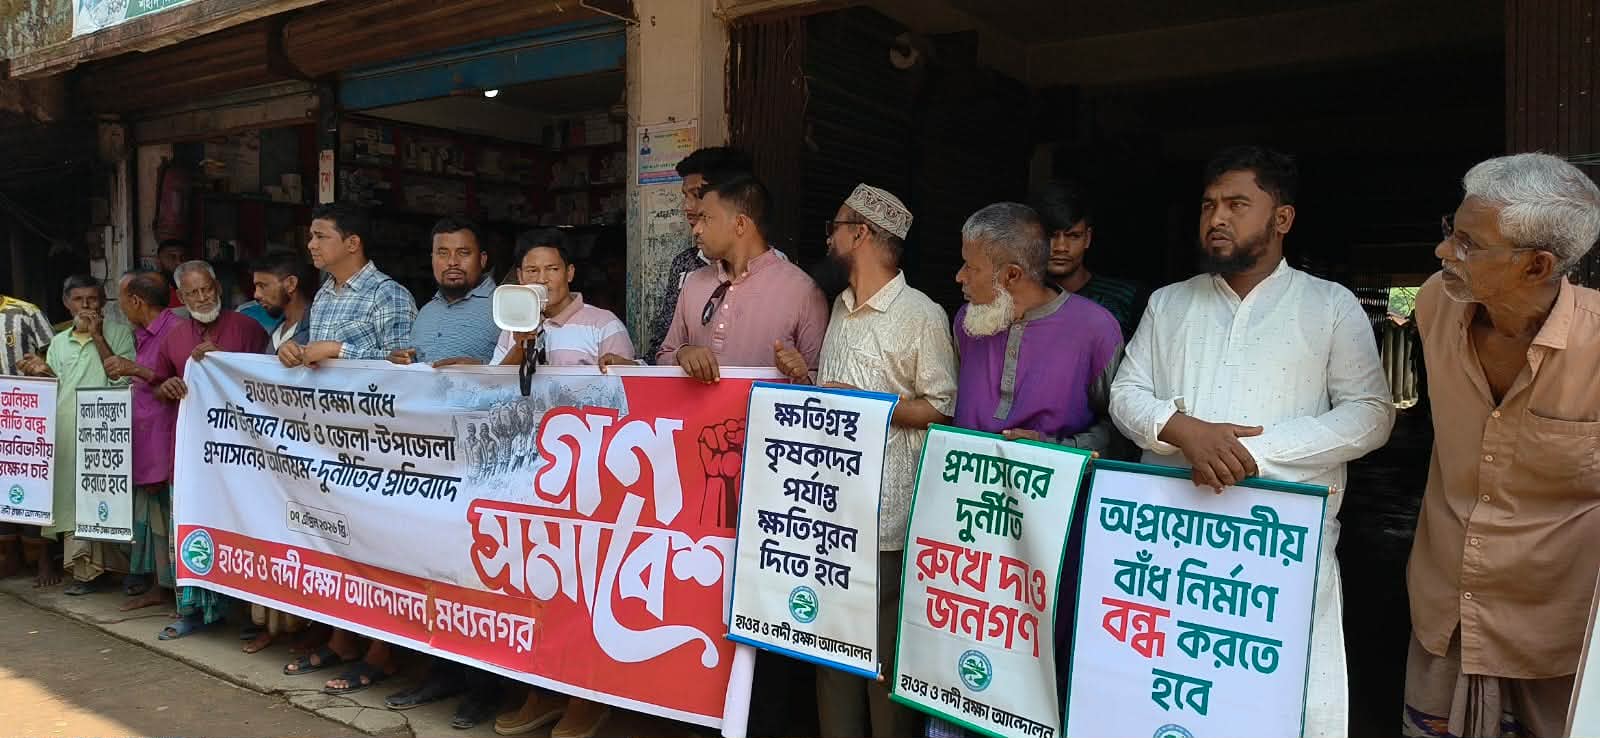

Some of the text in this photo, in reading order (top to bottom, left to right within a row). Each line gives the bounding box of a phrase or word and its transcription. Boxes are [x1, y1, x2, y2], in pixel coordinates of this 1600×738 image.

[80, 403, 96, 418] বন্যা
[318, 388, 355, 414] রক্ষা
[358, 383, 396, 418] বাঁধে
[774, 398, 860, 442] ক্ষতিগ্রস্থ
[102, 447, 124, 471] শুরু
[109, 427, 131, 443] খনন
[313, 423, 325, 444] ও
[325, 423, 456, 461] জেলা-উপজেলা
[764, 437, 863, 476] কৃষকদের
[30, 459, 49, 481] চাই
[81, 473, 128, 495] করতে হবে
[203, 441, 265, 470] প্রশাসনের
[382, 462, 462, 502] প্রতিবাদে
[783, 472, 840, 513] পর্যাপ্ত
[942, 448, 1055, 500] প্রশাসনের
[290, 510, 300, 523] ০৭
[758, 506, 859, 555] ক্ষতিপুরন
[955, 491, 1024, 543] দুর্নীতি
[1099, 496, 1309, 567] অপ্রয়োজনীয়
[474, 492, 735, 669] সমাবেশ
[759, 538, 851, 590] দিতে হবে
[915, 535, 1048, 614] রুখে দাও
[1113, 549, 1279, 623] বাঁধ নির্মাণ
[218, 544, 256, 580] হাওর
[256, 553, 270, 583] ও
[270, 549, 302, 590] নদী
[302, 563, 343, 600] রক্ষা
[434, 597, 537, 653] মধ্যনগর
[925, 586, 1041, 658] জনগণ
[735, 614, 873, 662] হাওর ও নদী রক্ষা আন্দোলন
[1101, 596, 1283, 675] বন্ধ করতে
[900, 673, 1056, 738] হাওর ও নদী রক্ষা আন্দোলন
[1151, 667, 1213, 716] হবে
